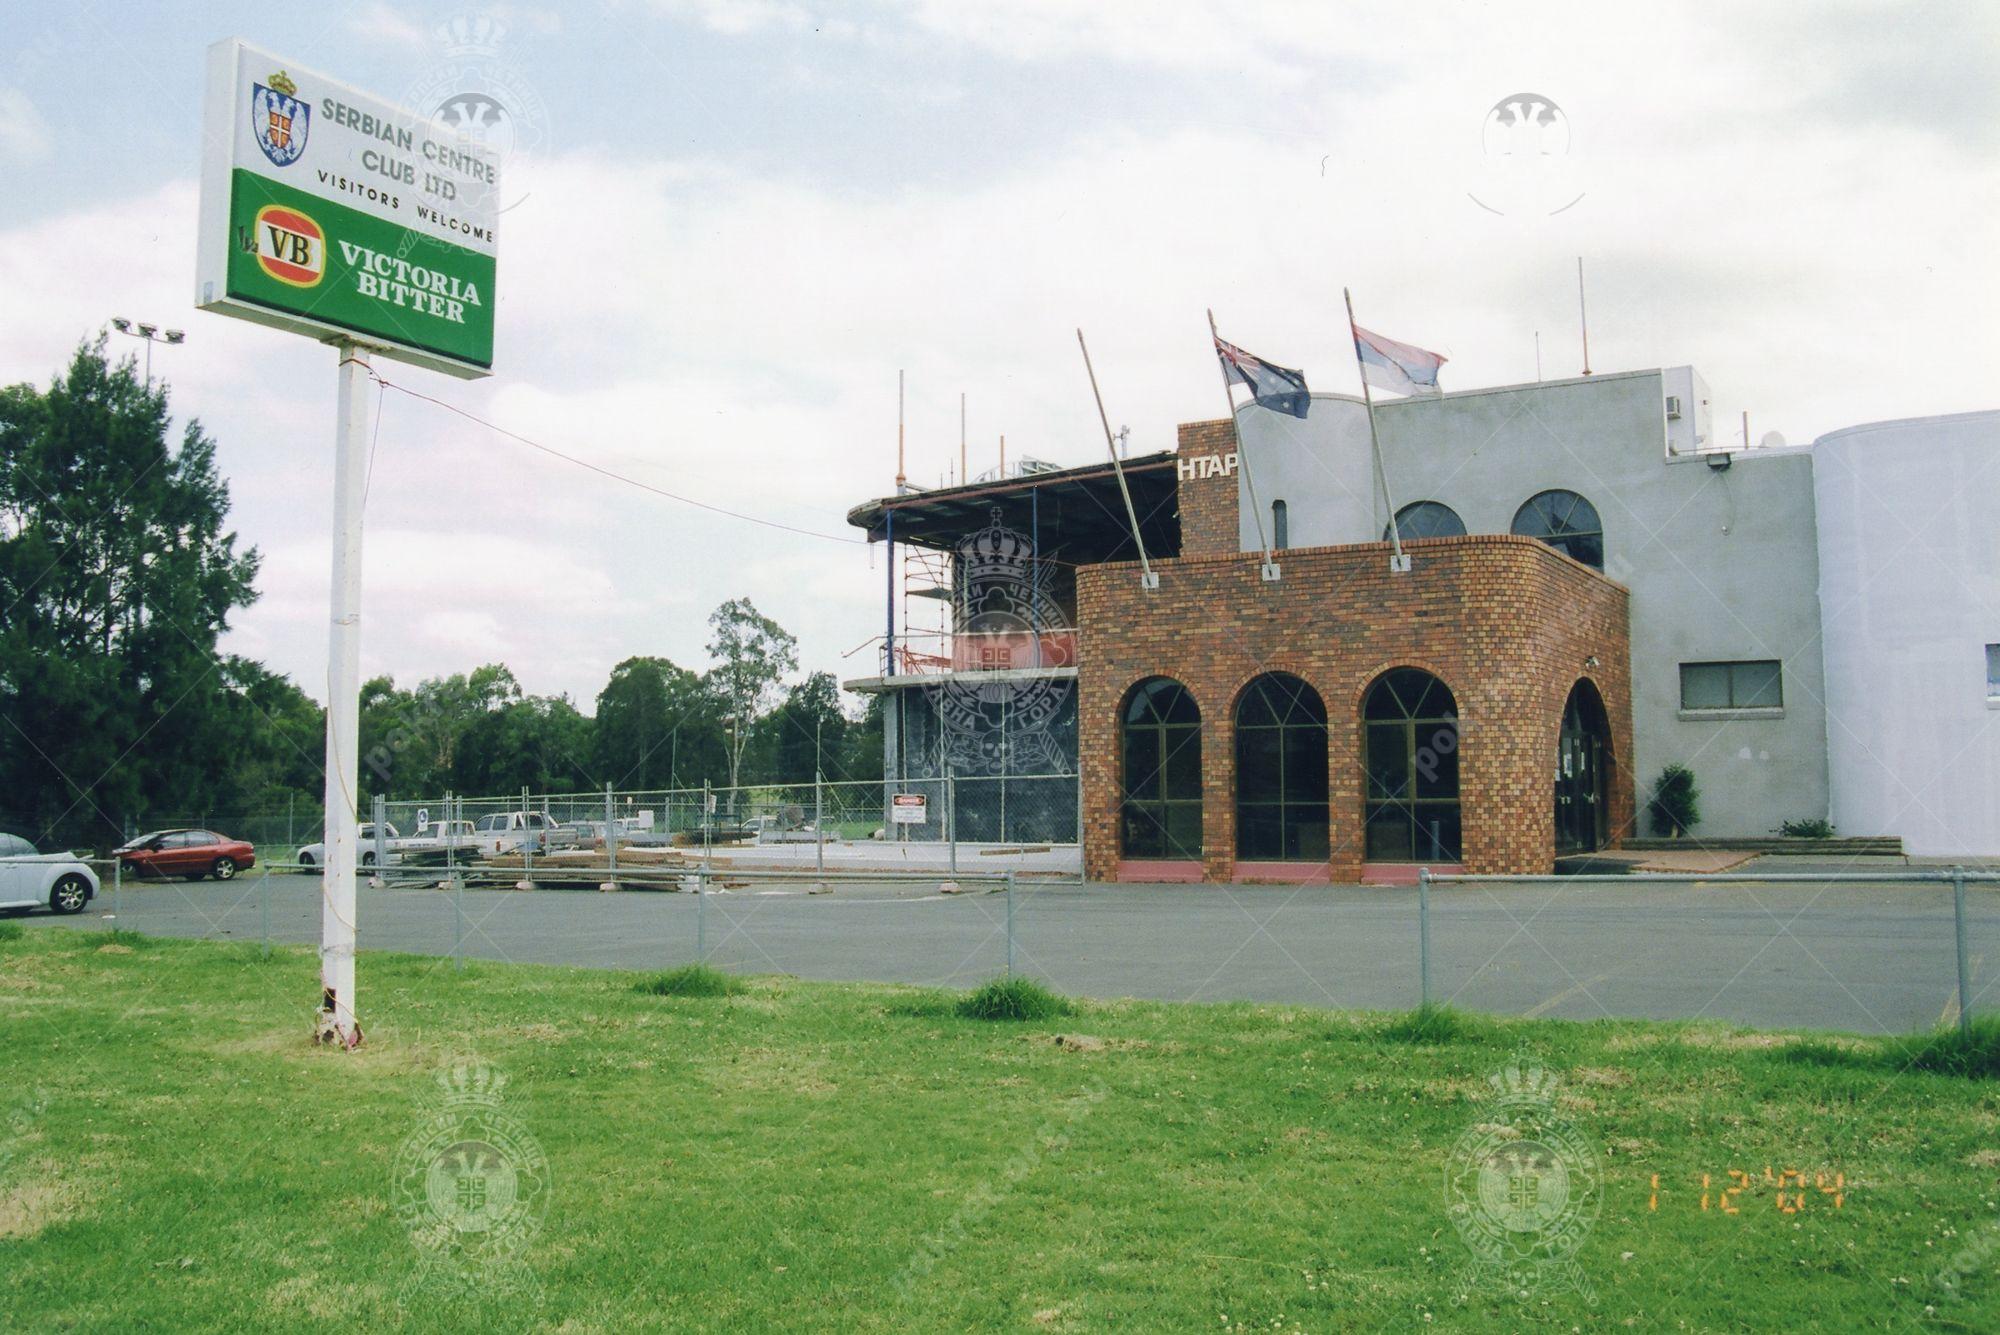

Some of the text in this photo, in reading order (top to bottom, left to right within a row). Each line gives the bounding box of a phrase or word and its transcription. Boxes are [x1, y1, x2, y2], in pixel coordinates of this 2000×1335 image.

[322, 97, 495, 185] SERBIAN CENTRE
[362, 150, 457, 202] CLUB LTD
[318, 169, 493, 243] VISITORS WELCOME
[267, 225, 311, 266] VB
[338, 240, 481, 306] VICTORIA
[357, 272, 465, 324] BITTER
